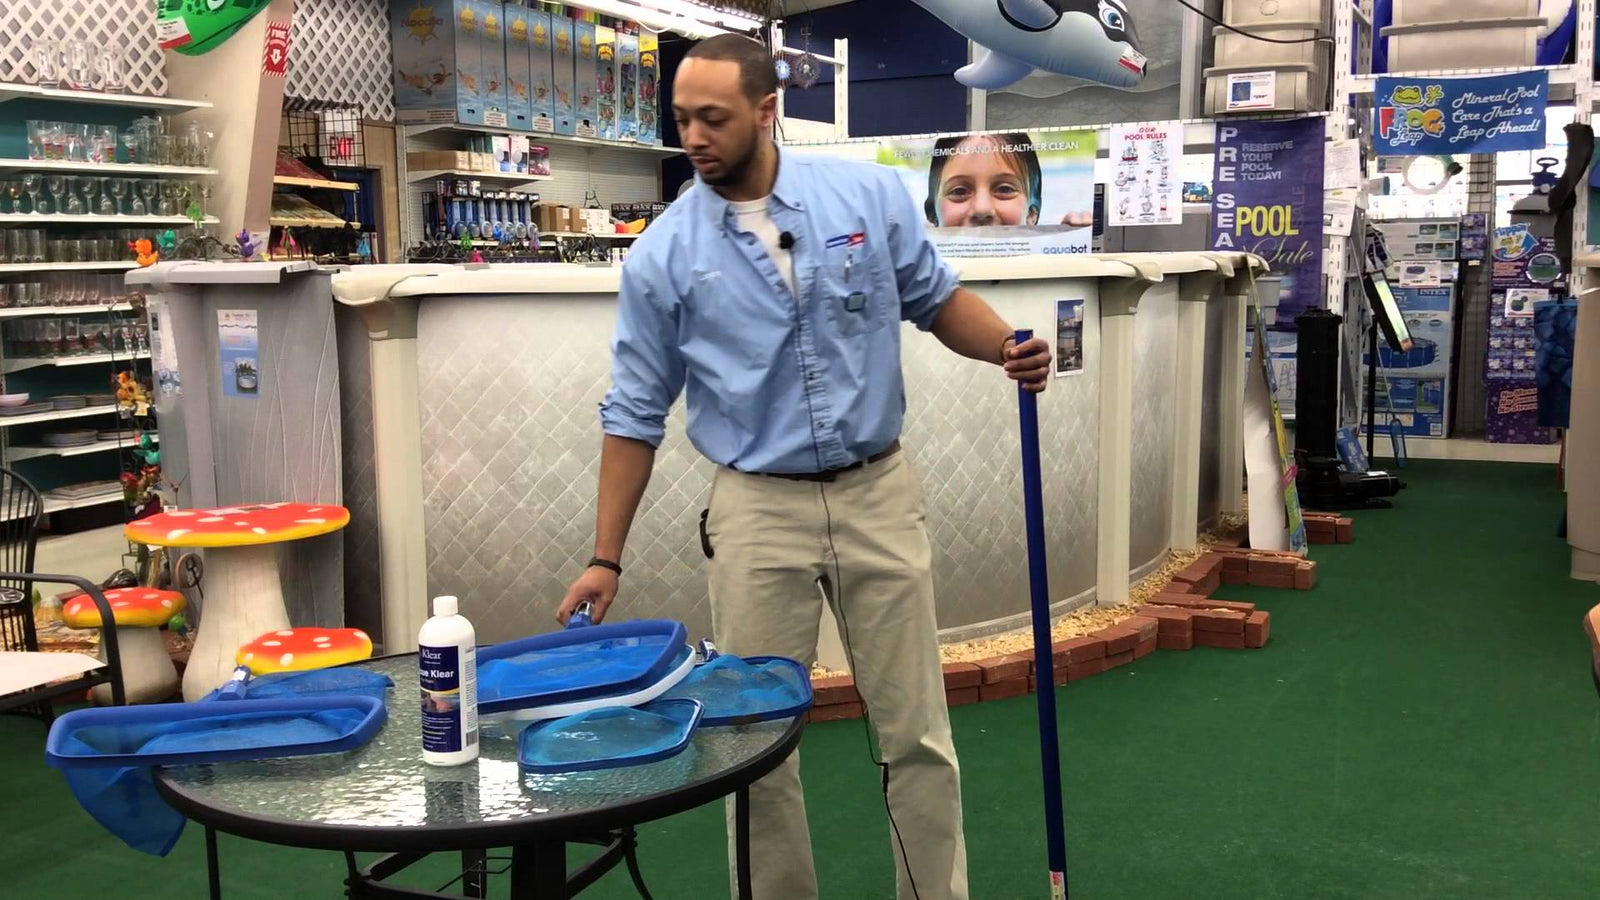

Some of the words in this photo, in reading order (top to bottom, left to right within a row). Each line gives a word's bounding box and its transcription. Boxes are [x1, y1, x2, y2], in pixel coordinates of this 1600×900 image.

[1452, 89, 1507, 109] Mineral
[1507, 84, 1540, 104] Pool
[1452, 109, 1481, 123] Care
[1482, 103, 1522, 122] That's
[1524, 107, 1534, 115] a
[1379, 106, 1445, 139] FROG
[1390, 129, 1424, 146] Leap
[1449, 125, 1485, 143] Leap
[1486, 119, 1541, 138] Ahead!
[1001, 143, 1047, 152] HEALTHIER
[1049, 141, 1079, 150] CLEAN
[1241, 140, 1294, 152] RESERVE
[1219, 127, 1238, 182] PRE
[1241, 152, 1273, 162] YOUR
[1241, 161, 1273, 172] POOL
[1241, 171, 1282, 181] TODAY!
[1235, 204, 1300, 237] POOL
[1043, 244, 1087, 255] aquabot
[1250, 237, 1315, 265] Sale
[422, 649, 441, 659] Klear
[430, 669, 454, 678] Klear
